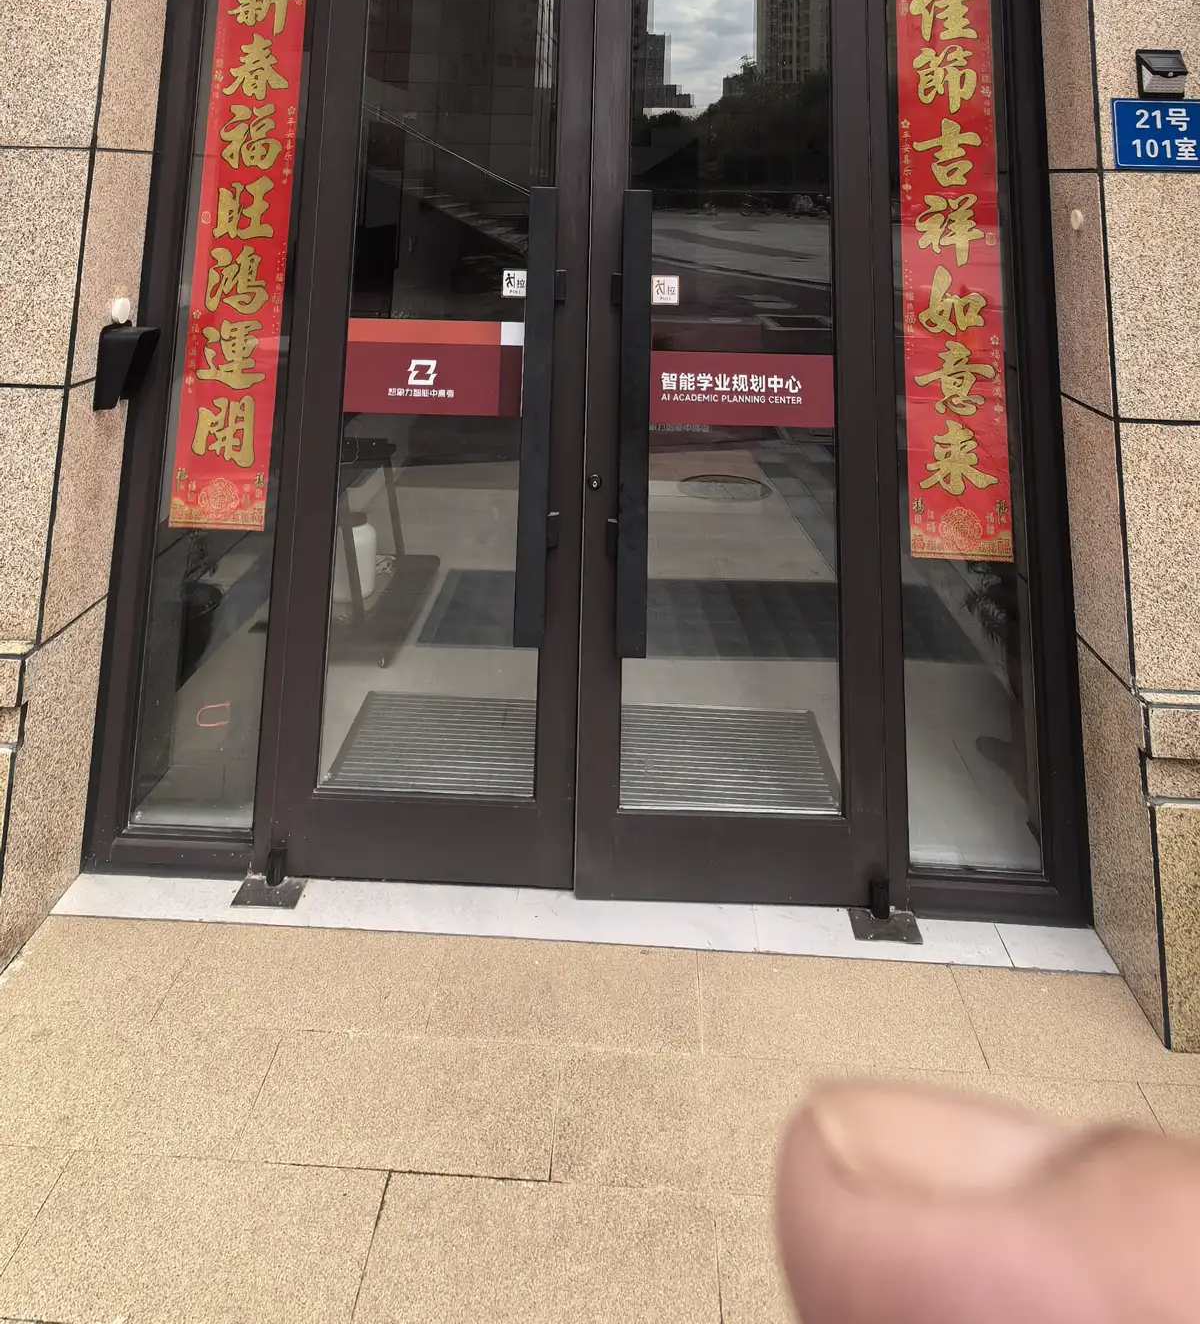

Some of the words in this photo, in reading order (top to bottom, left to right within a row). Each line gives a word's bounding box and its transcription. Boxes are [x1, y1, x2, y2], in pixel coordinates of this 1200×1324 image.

[1135, 107, 1190, 132] 21号
[1131, 137, 1199, 162] 101室
[661, 372, 802, 393] 智能学业规划中心
[673, 394, 719, 403] ACADEMIC
[721, 395, 766, 404] PLANNING
[768, 396, 803, 405] CENTER
